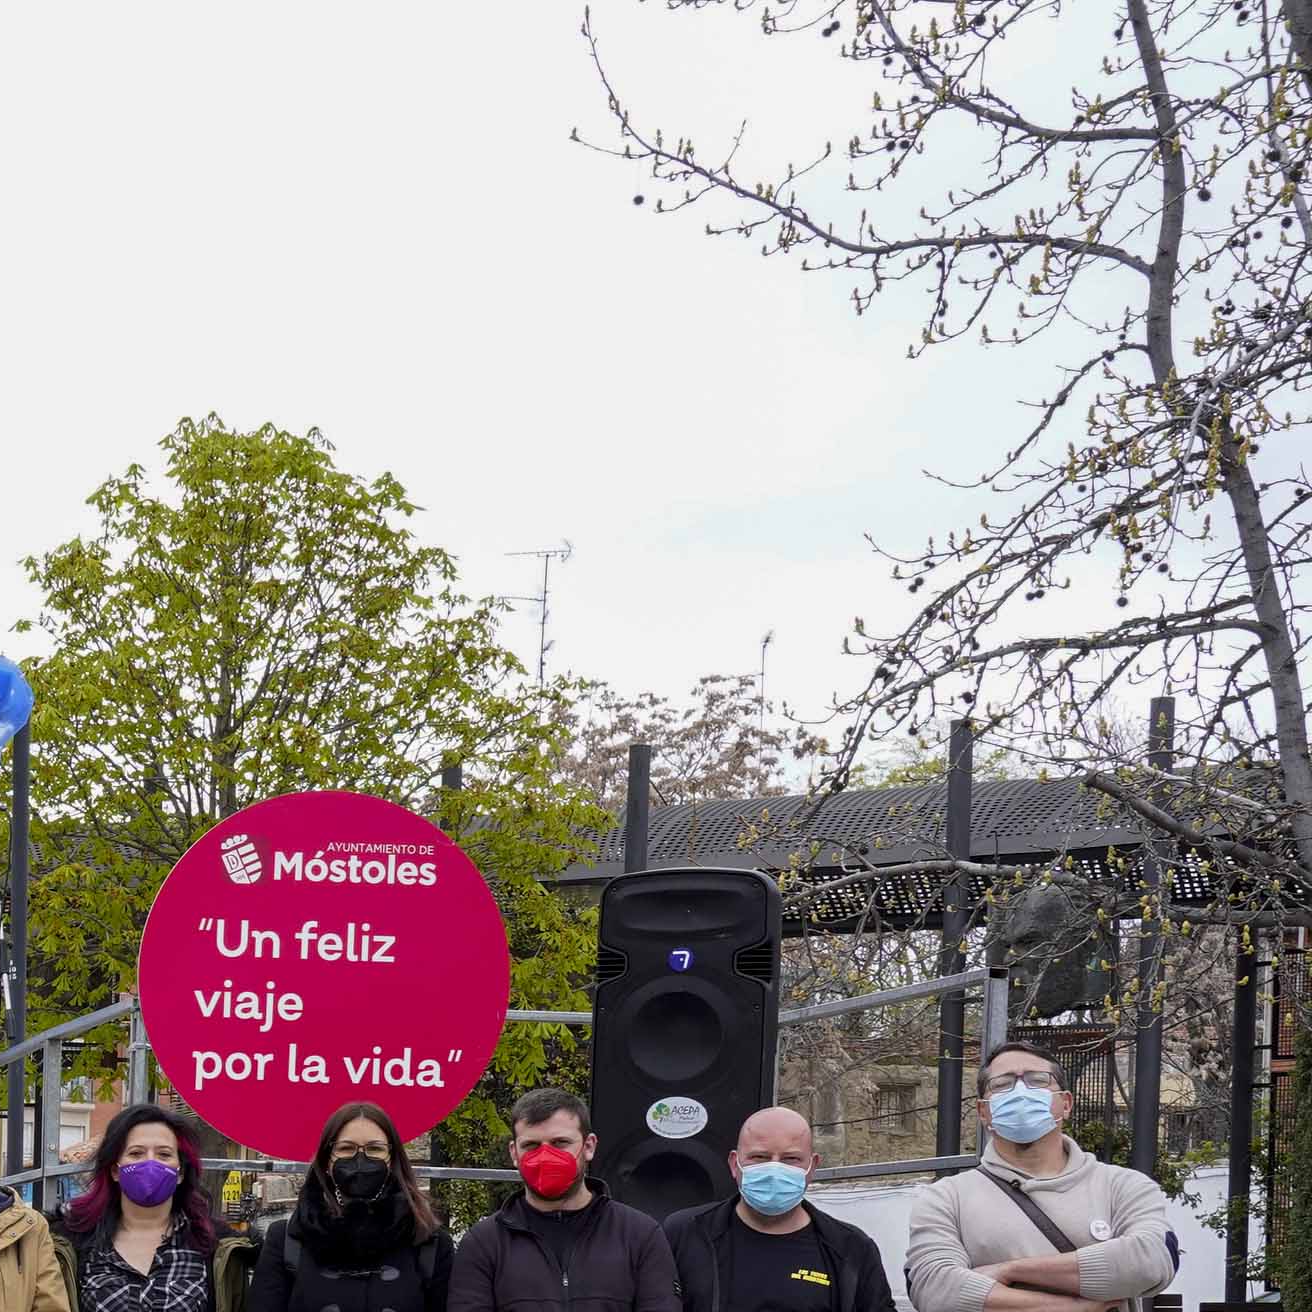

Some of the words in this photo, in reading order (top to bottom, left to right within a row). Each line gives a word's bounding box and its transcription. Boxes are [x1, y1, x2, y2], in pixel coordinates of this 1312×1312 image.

[273, 848, 437, 886] Móstoles
[327, 842, 415, 857] AYUNTAMIENTO
[418, 845, 434, 856] DE
[295, 920, 396, 963] feliz
[194, 979, 304, 1033] viaje
[191, 1050, 274, 1091] por
[287, 1043, 330, 1084] la
